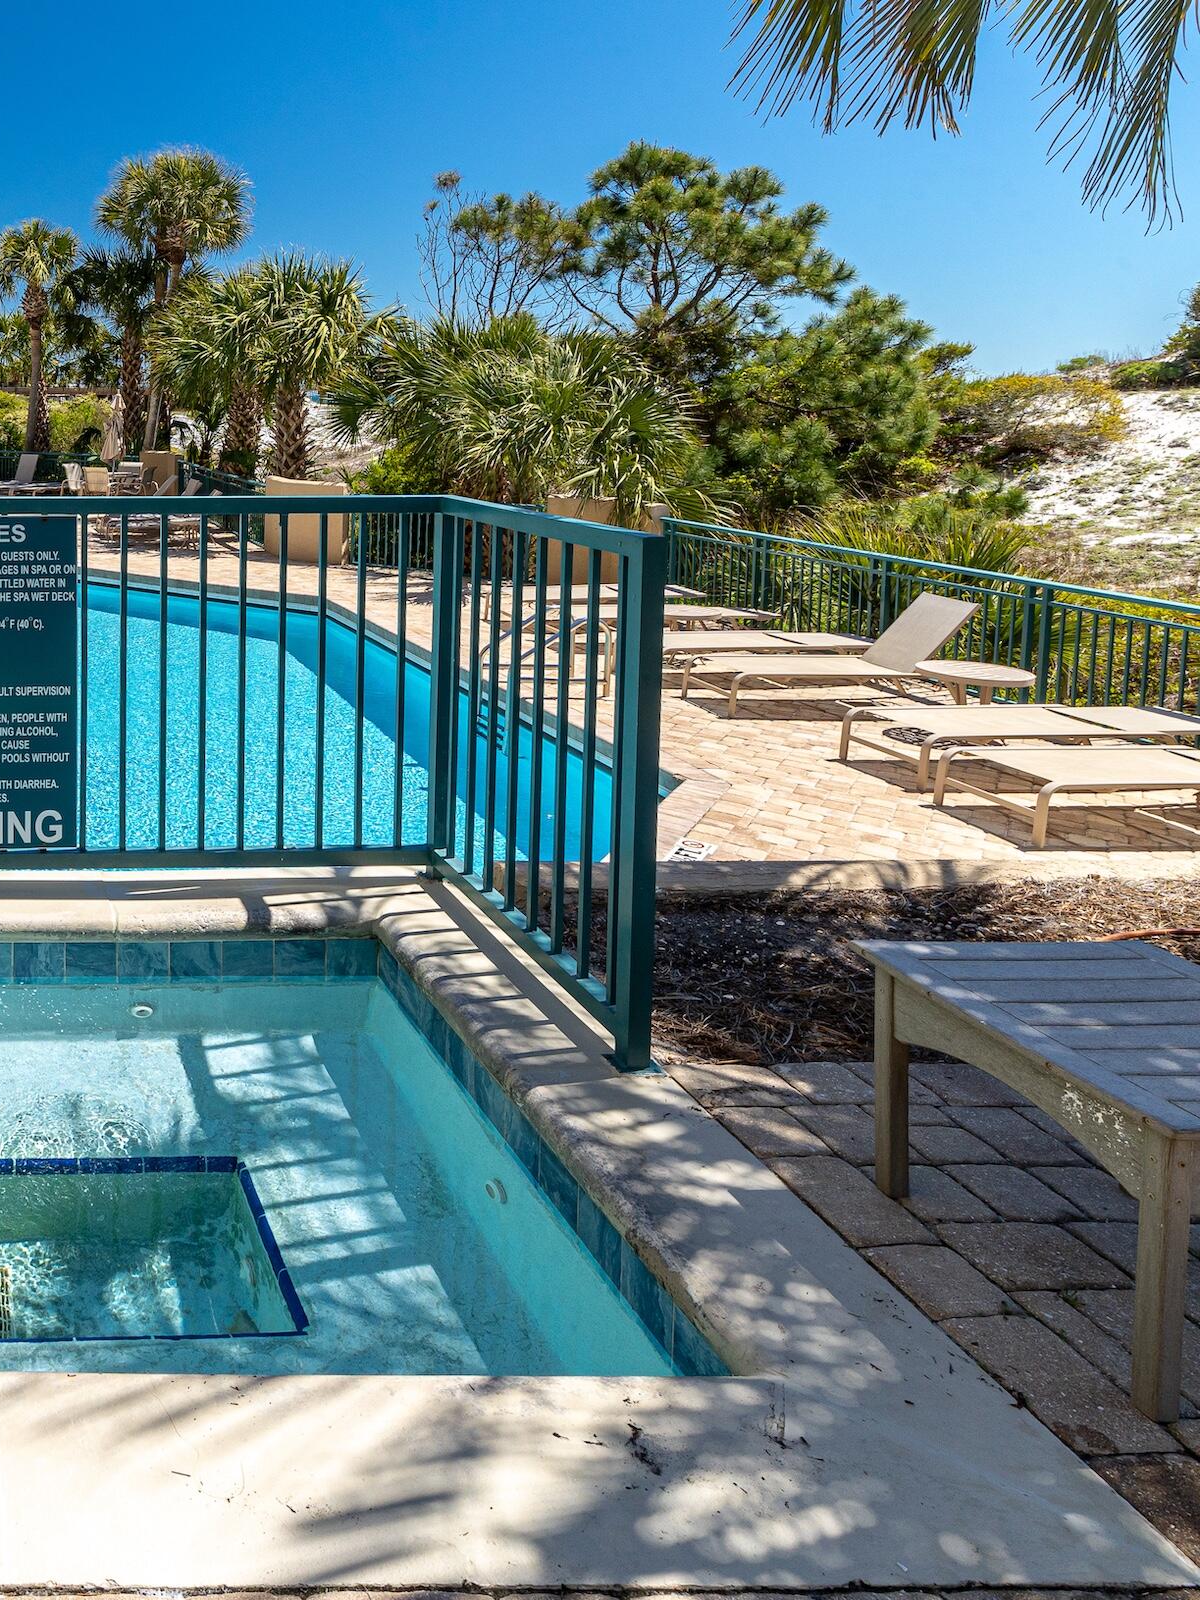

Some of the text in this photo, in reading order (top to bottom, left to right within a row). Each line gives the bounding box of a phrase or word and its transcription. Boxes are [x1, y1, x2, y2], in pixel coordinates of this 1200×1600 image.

[1, 552, 35, 561] GUESTS
[36, 551, 59, 561] ONLY.
[20, 565, 29, 574] IN
[31, 565, 47, 574] SPA
[49, 564, 61, 574] OR
[63, 564, 76, 574] ON
[26, 578, 55, 588] WATER
[57, 578, 66, 587] IN
[13, 592, 30, 601] SPA
[31, 592, 50, 601] WET
[52, 592, 75, 601] DECK
[15, 686, 71, 696] SUPERVISION
[11, 713, 44, 722] PEOPLE
[46, 713, 67, 722] WITH
[16, 727, 58, 738] ALCOHOL,
[1, 740, 30, 749] CAUSE
[2, 753, 30, 762] POOLS
[32, 753, 70, 762] WITHOUT
[14, 780, 59, 789] DIARRHEA.
